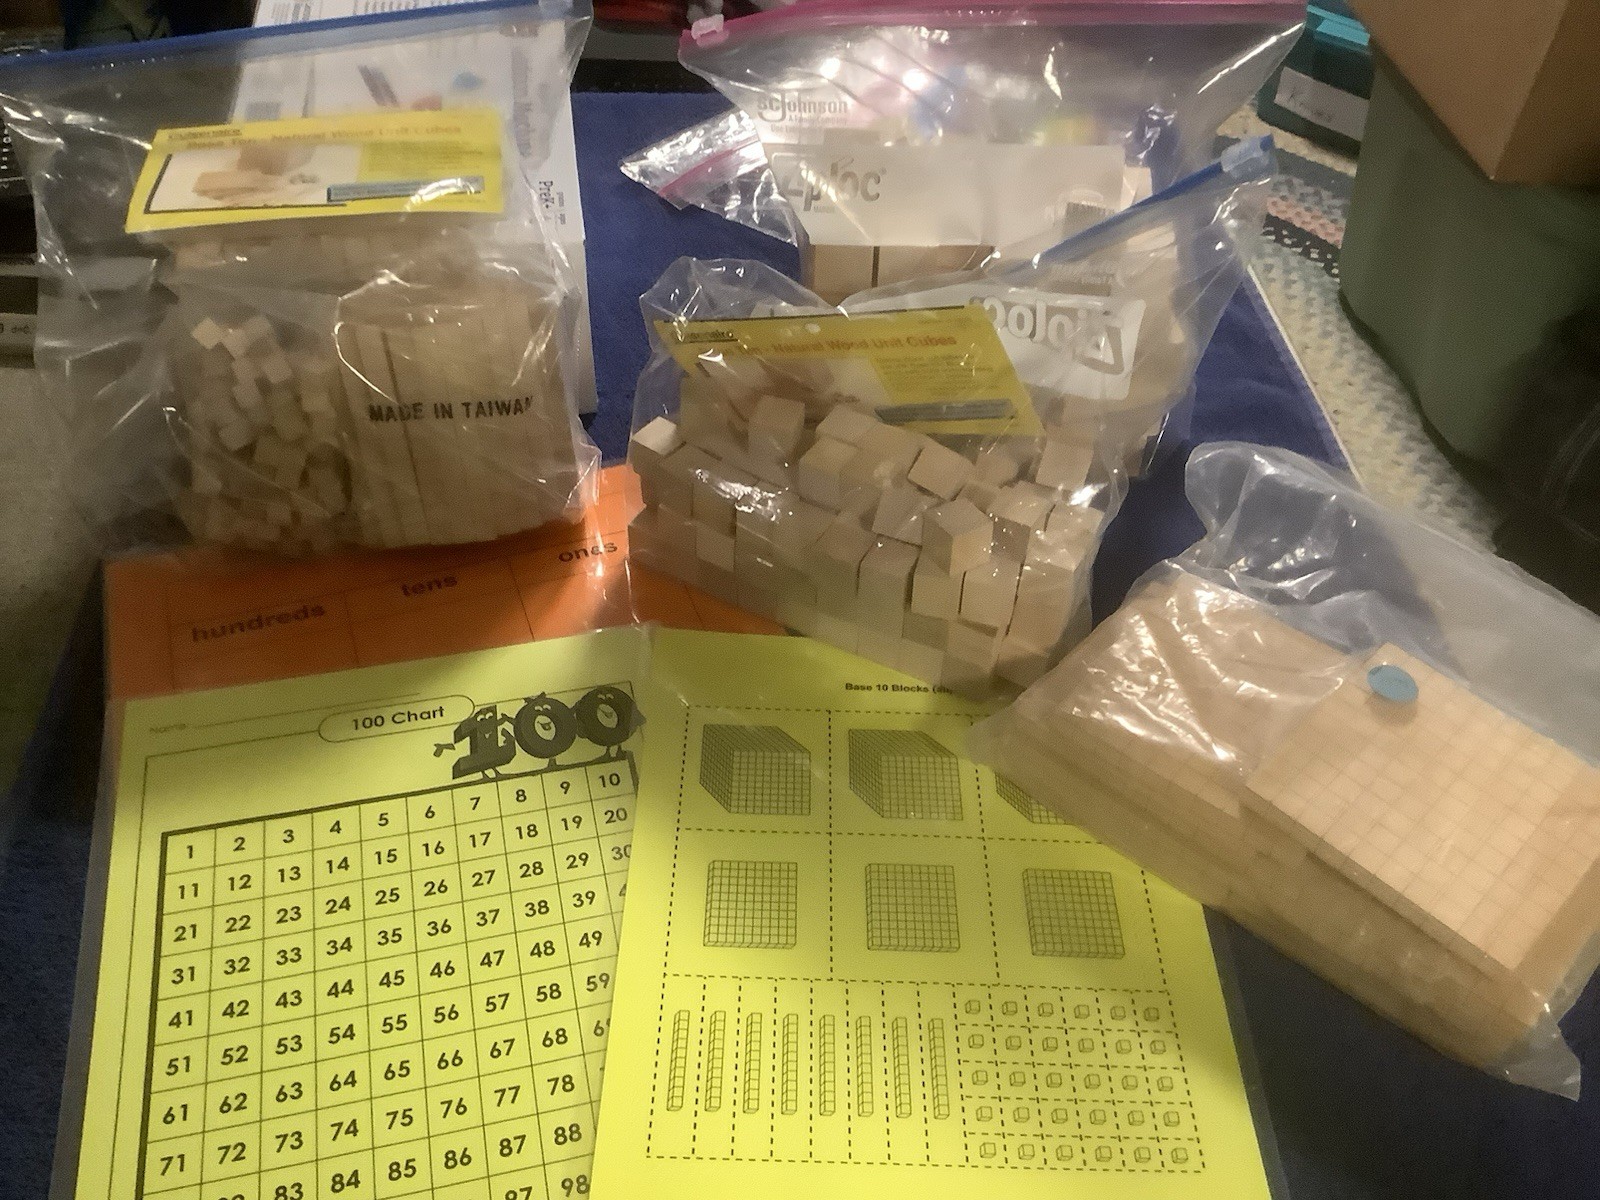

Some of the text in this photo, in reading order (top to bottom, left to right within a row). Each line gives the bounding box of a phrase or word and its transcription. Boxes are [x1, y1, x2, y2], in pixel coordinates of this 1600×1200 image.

[826, 338, 869, 351] Wood
[871, 337, 903, 349] Unit
[906, 334, 957, 347] Cubes
[368, 402, 424, 422] MADE
[433, 403, 454, 420] IN
[400, 573, 459, 598] tens
[558, 541, 618, 563] ones
[190, 602, 326, 643] hundreds
[352, 705, 446, 731] 100 Chart
[845, 682, 873, 691] Base
[876, 684, 889, 692] 10
[892, 684, 930, 693] Blocks
[178, 807, 629, 900] 11 12 13 14 15 16 17 18 19 20
[186, 772, 621, 860] 1 2 3 4 5 6 7 8 9 10
[173, 923, 198, 943] 21
[224, 914, 252, 934] 22
[275, 905, 303, 925] 23
[324, 895, 352, 916] 24
[374, 886, 401, 906] 25
[423, 878, 449, 898] 26
[471, 868, 496, 888] 27
[518, 860, 545, 879] 28
[565, 851, 590, 870] 29
[171, 890, 596, 986] 31 32 33 34 35 36 37 38 39
[168, 929, 603, 1029] 41 42 43 44 45 46 47 48 49
[165, 972, 611, 1077] 51 52 53 54 55 56 57 58 59
[162, 1103, 189, 1126] 61
[218, 1091, 248, 1115] 62
[274, 1081, 304, 1104] 63
[328, 1069, 358, 1093] 64
[383, 1059, 411, 1082] 65
[436, 1049, 464, 1071] 66
[489, 1037, 516, 1060] 67
[541, 1027, 569, 1049] 68
[160, 1073, 576, 1177] 71 72 73 74 75 76 77 78
[273, 1122, 583, 1200] 83 84 85 86 87 88
[560, 1174, 592, 1198] 98
